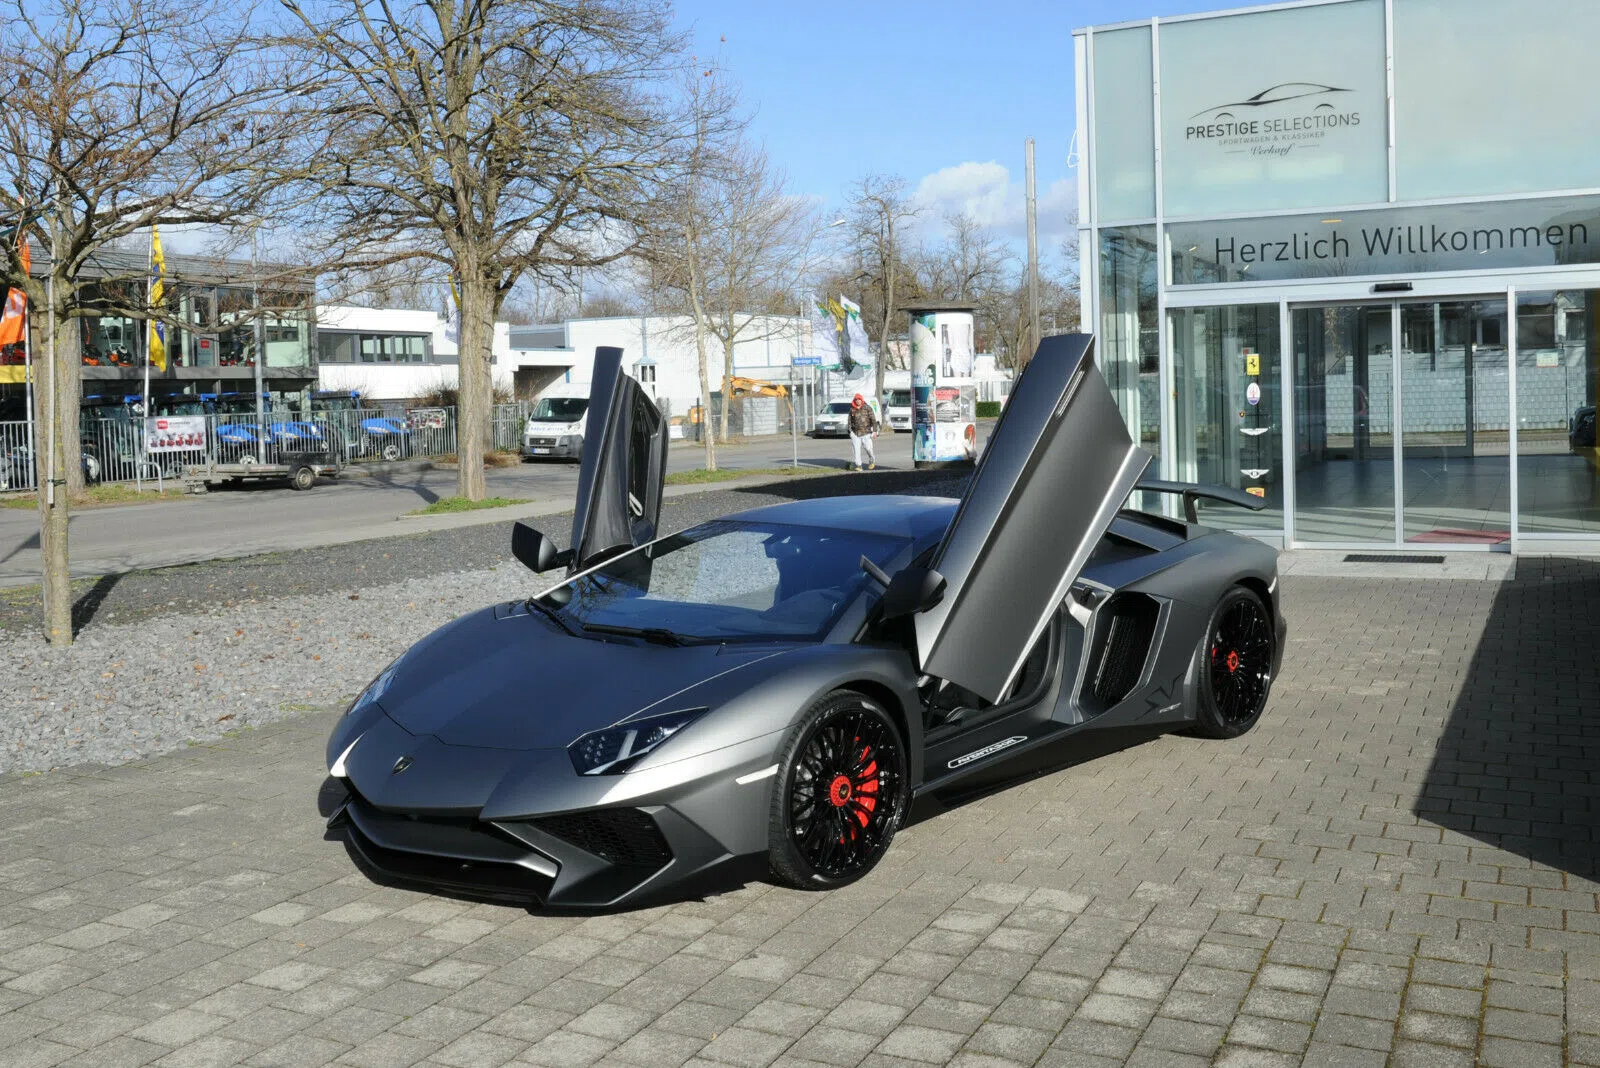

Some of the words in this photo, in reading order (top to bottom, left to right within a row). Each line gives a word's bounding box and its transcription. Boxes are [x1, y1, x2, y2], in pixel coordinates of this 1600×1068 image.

[1186, 121, 1259, 140] PRESTIGE
[1263, 112, 1361, 133] SELECTIONS
[1218, 135, 1271, 146] SPORTWAGEN
[1281, 131, 1326, 141] KLASSIKER
[1215, 231, 1350, 265] Herzlich
[1362, 223, 1589, 257] Willkommen
